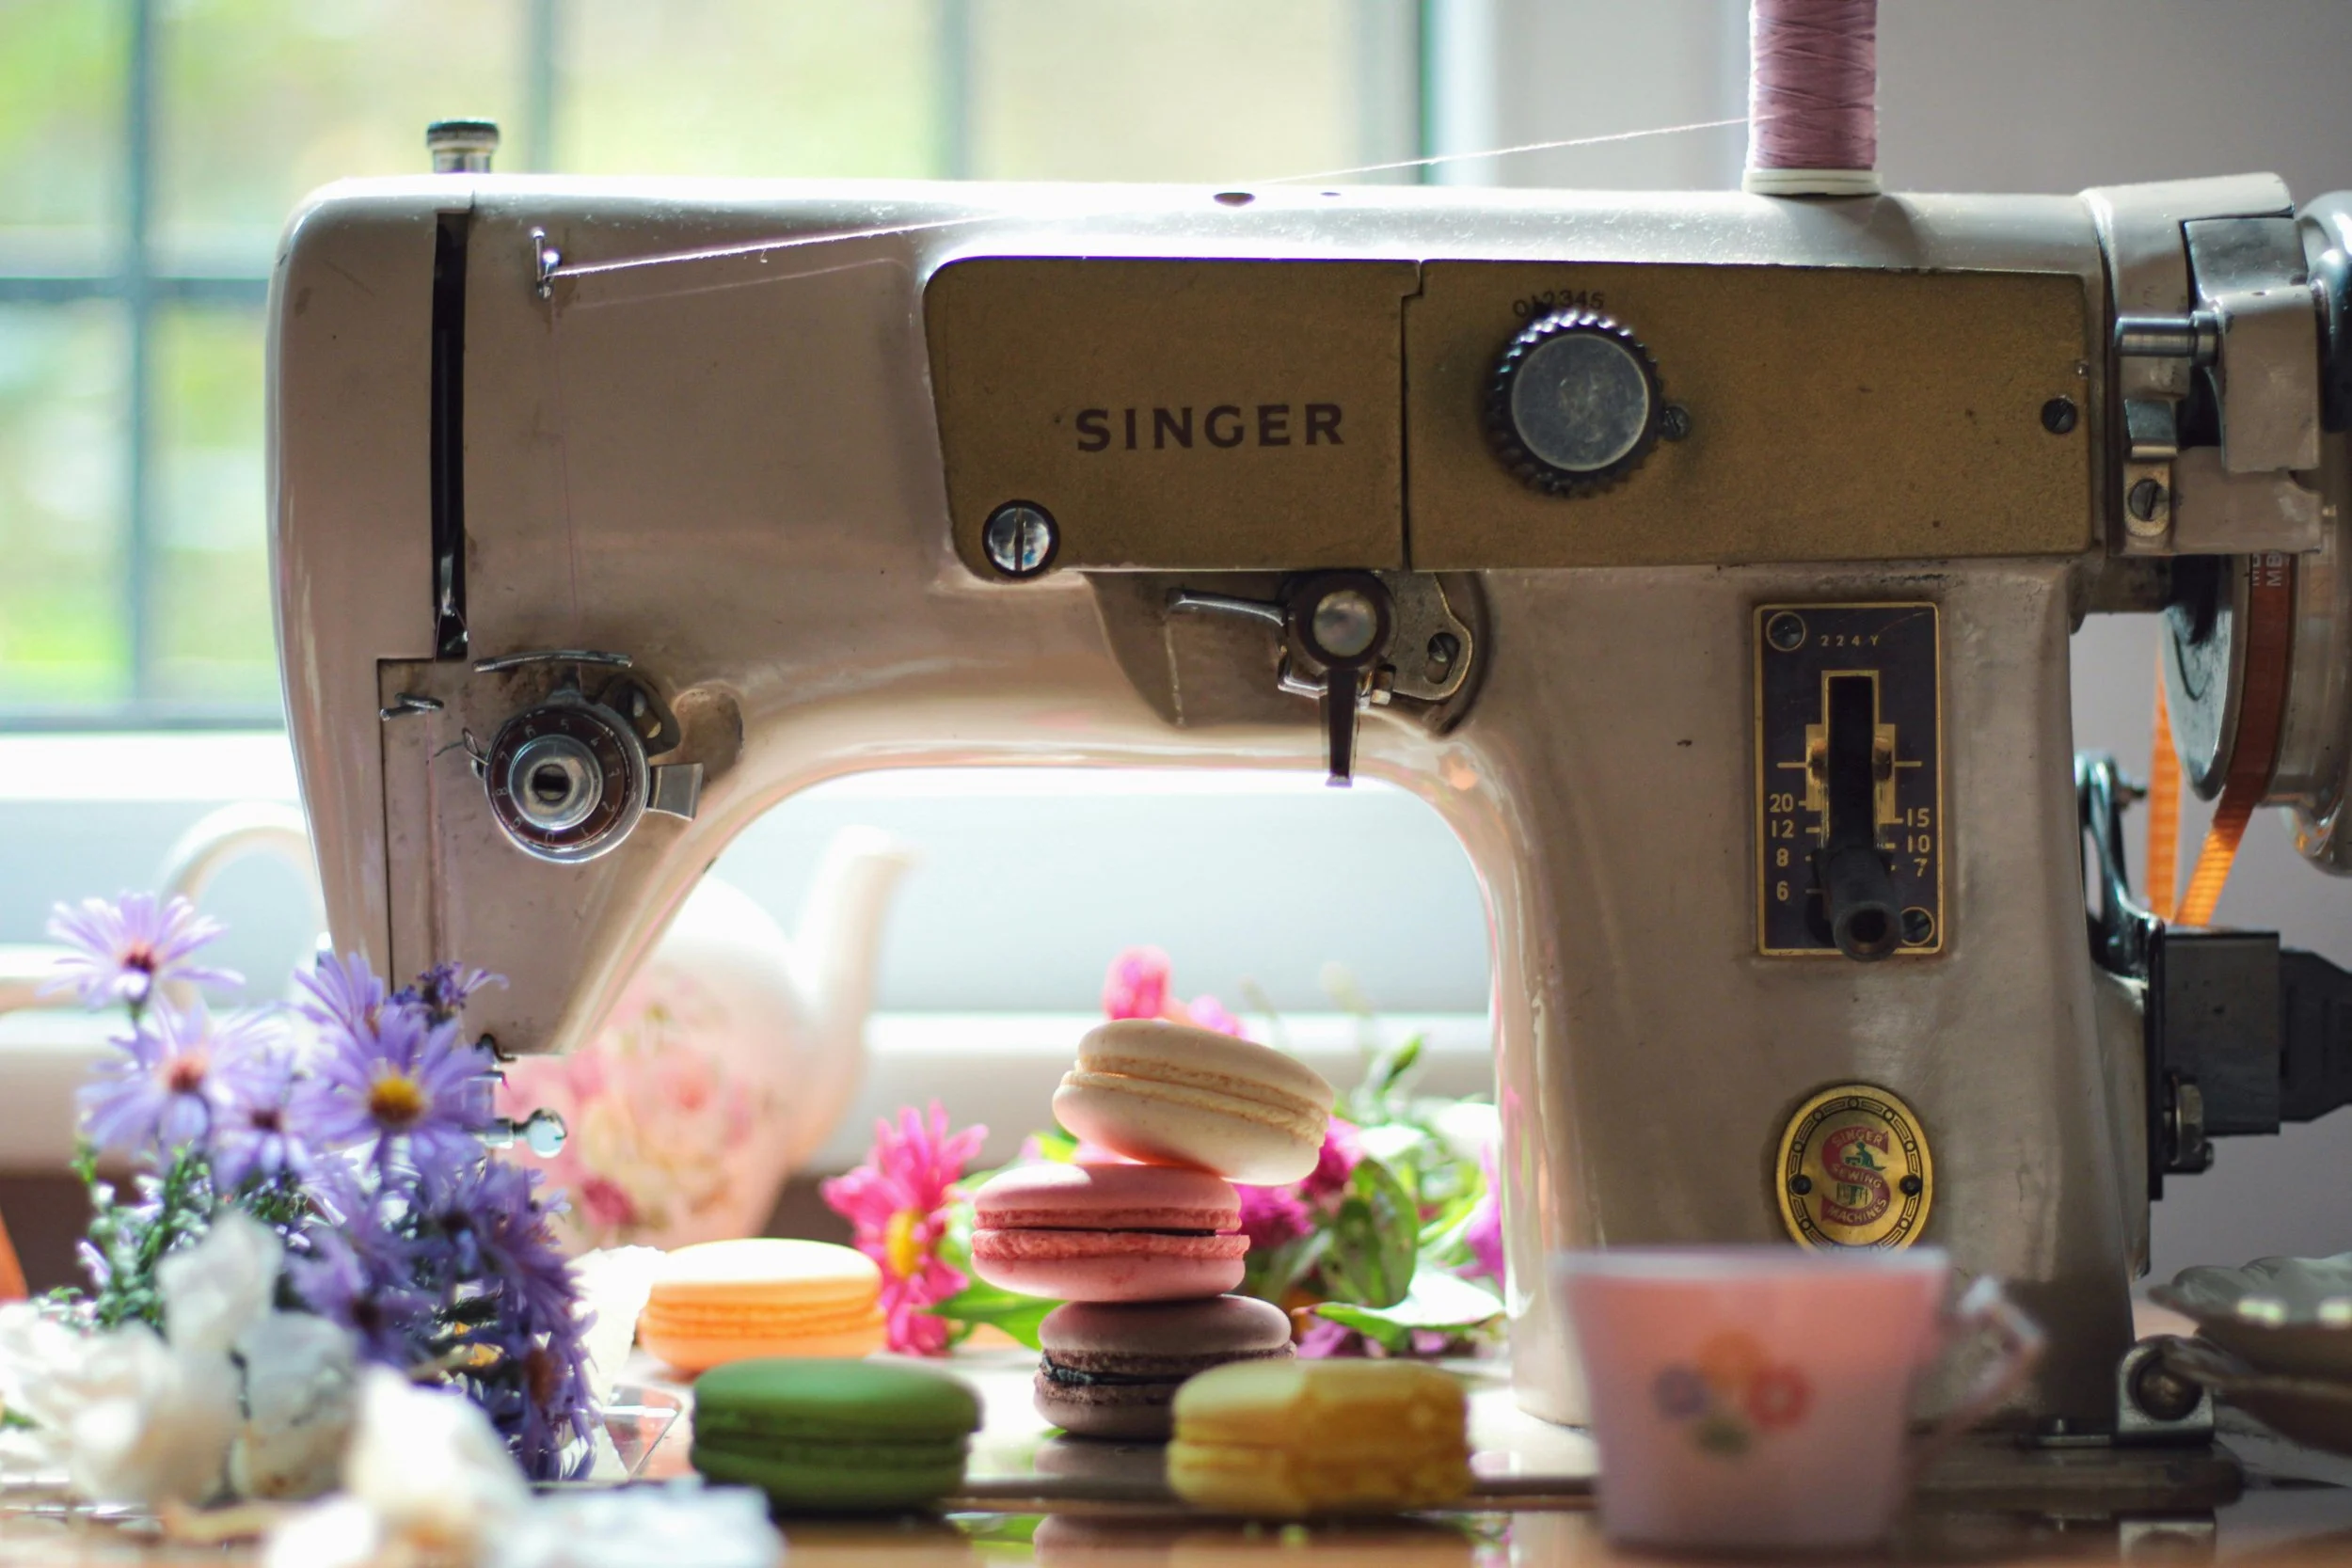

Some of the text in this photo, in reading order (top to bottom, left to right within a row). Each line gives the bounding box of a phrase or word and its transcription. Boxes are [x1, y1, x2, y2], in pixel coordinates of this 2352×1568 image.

[1075, 404, 1344, 452] SINGER
[1769, 793, 1794, 813] 20
[1772, 818, 1794, 838] 12
[1907, 808, 1930, 828] 15
[1907, 834, 1931, 853] 10
[1776, 847, 1788, 866] 8
[1914, 858, 1928, 877] 7
[1776, 880, 1788, 901] 6
[1831, 1131, 1883, 1147] SINGER
[1832, 1163, 1883, 1189] SEWING
[1828, 1197, 1887, 1224] MACHINES
